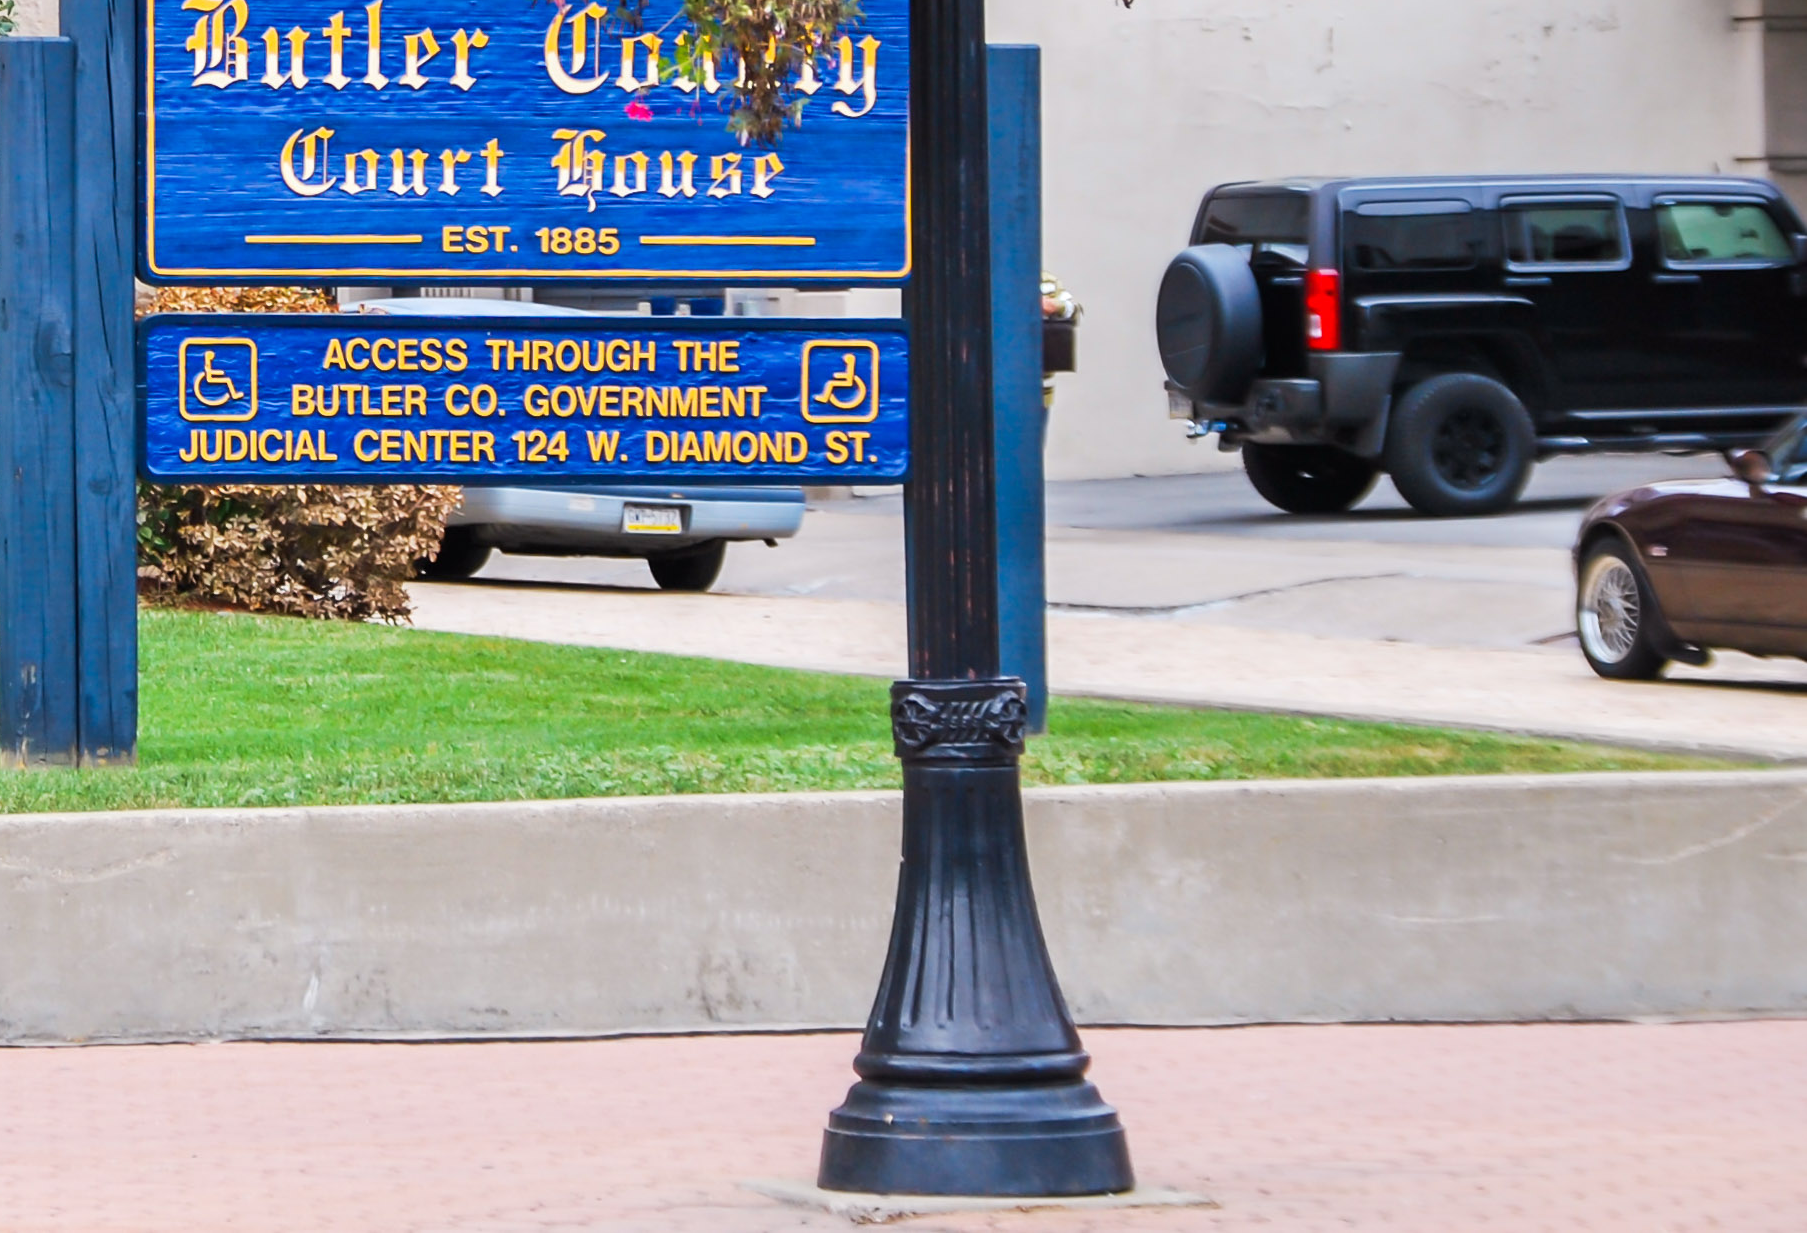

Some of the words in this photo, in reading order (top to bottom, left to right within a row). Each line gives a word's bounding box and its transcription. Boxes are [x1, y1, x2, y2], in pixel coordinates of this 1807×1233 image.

[279, 126, 506, 200] Court
[550, 128, 786, 213] House
[441, 225, 519, 254] EST.
[535, 226, 621, 255] 1885
[321, 337, 468, 372] ACCESS
[486, 338, 656, 372] THROUGH
[672, 340, 740, 372] THE
[291, 383, 427, 417] BUTLER
[444, 383, 506, 418] CO.
[523, 384, 768, 418] GOVERNMENT
[179, 428, 337, 462] JUDICIAL
[353, 428, 496, 462] CENTER
[511, 429, 570, 463] 124
[586, 430, 628, 463] W.
[645, 430, 808, 463] DIAMOND
[825, 431, 878, 464] ST.
